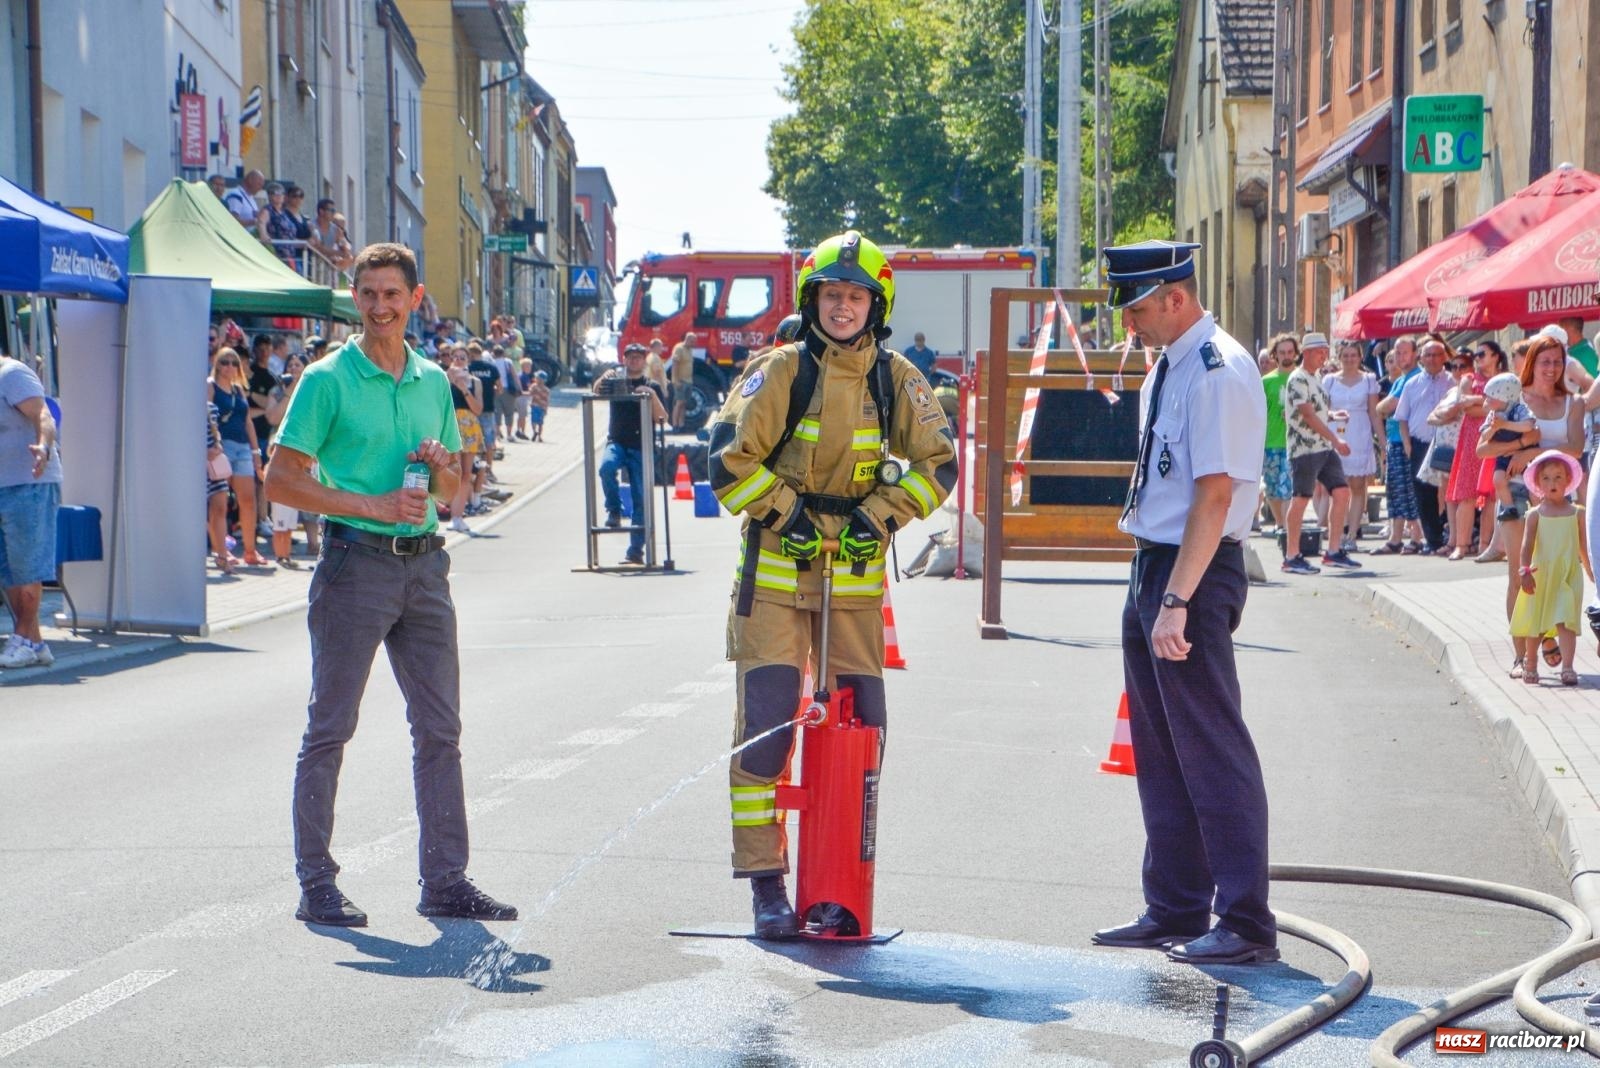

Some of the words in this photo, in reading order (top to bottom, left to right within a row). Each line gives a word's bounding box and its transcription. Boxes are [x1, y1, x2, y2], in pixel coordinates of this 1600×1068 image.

[1432, 103, 1457, 112] SKLEP
[186, 100, 202, 159] ŻYWIEC
[1413, 131, 1477, 166] ABC
[1392, 308, 1429, 328] RACIB
[720, 331, 742, 345] 569
[859, 465, 876, 477] STR
